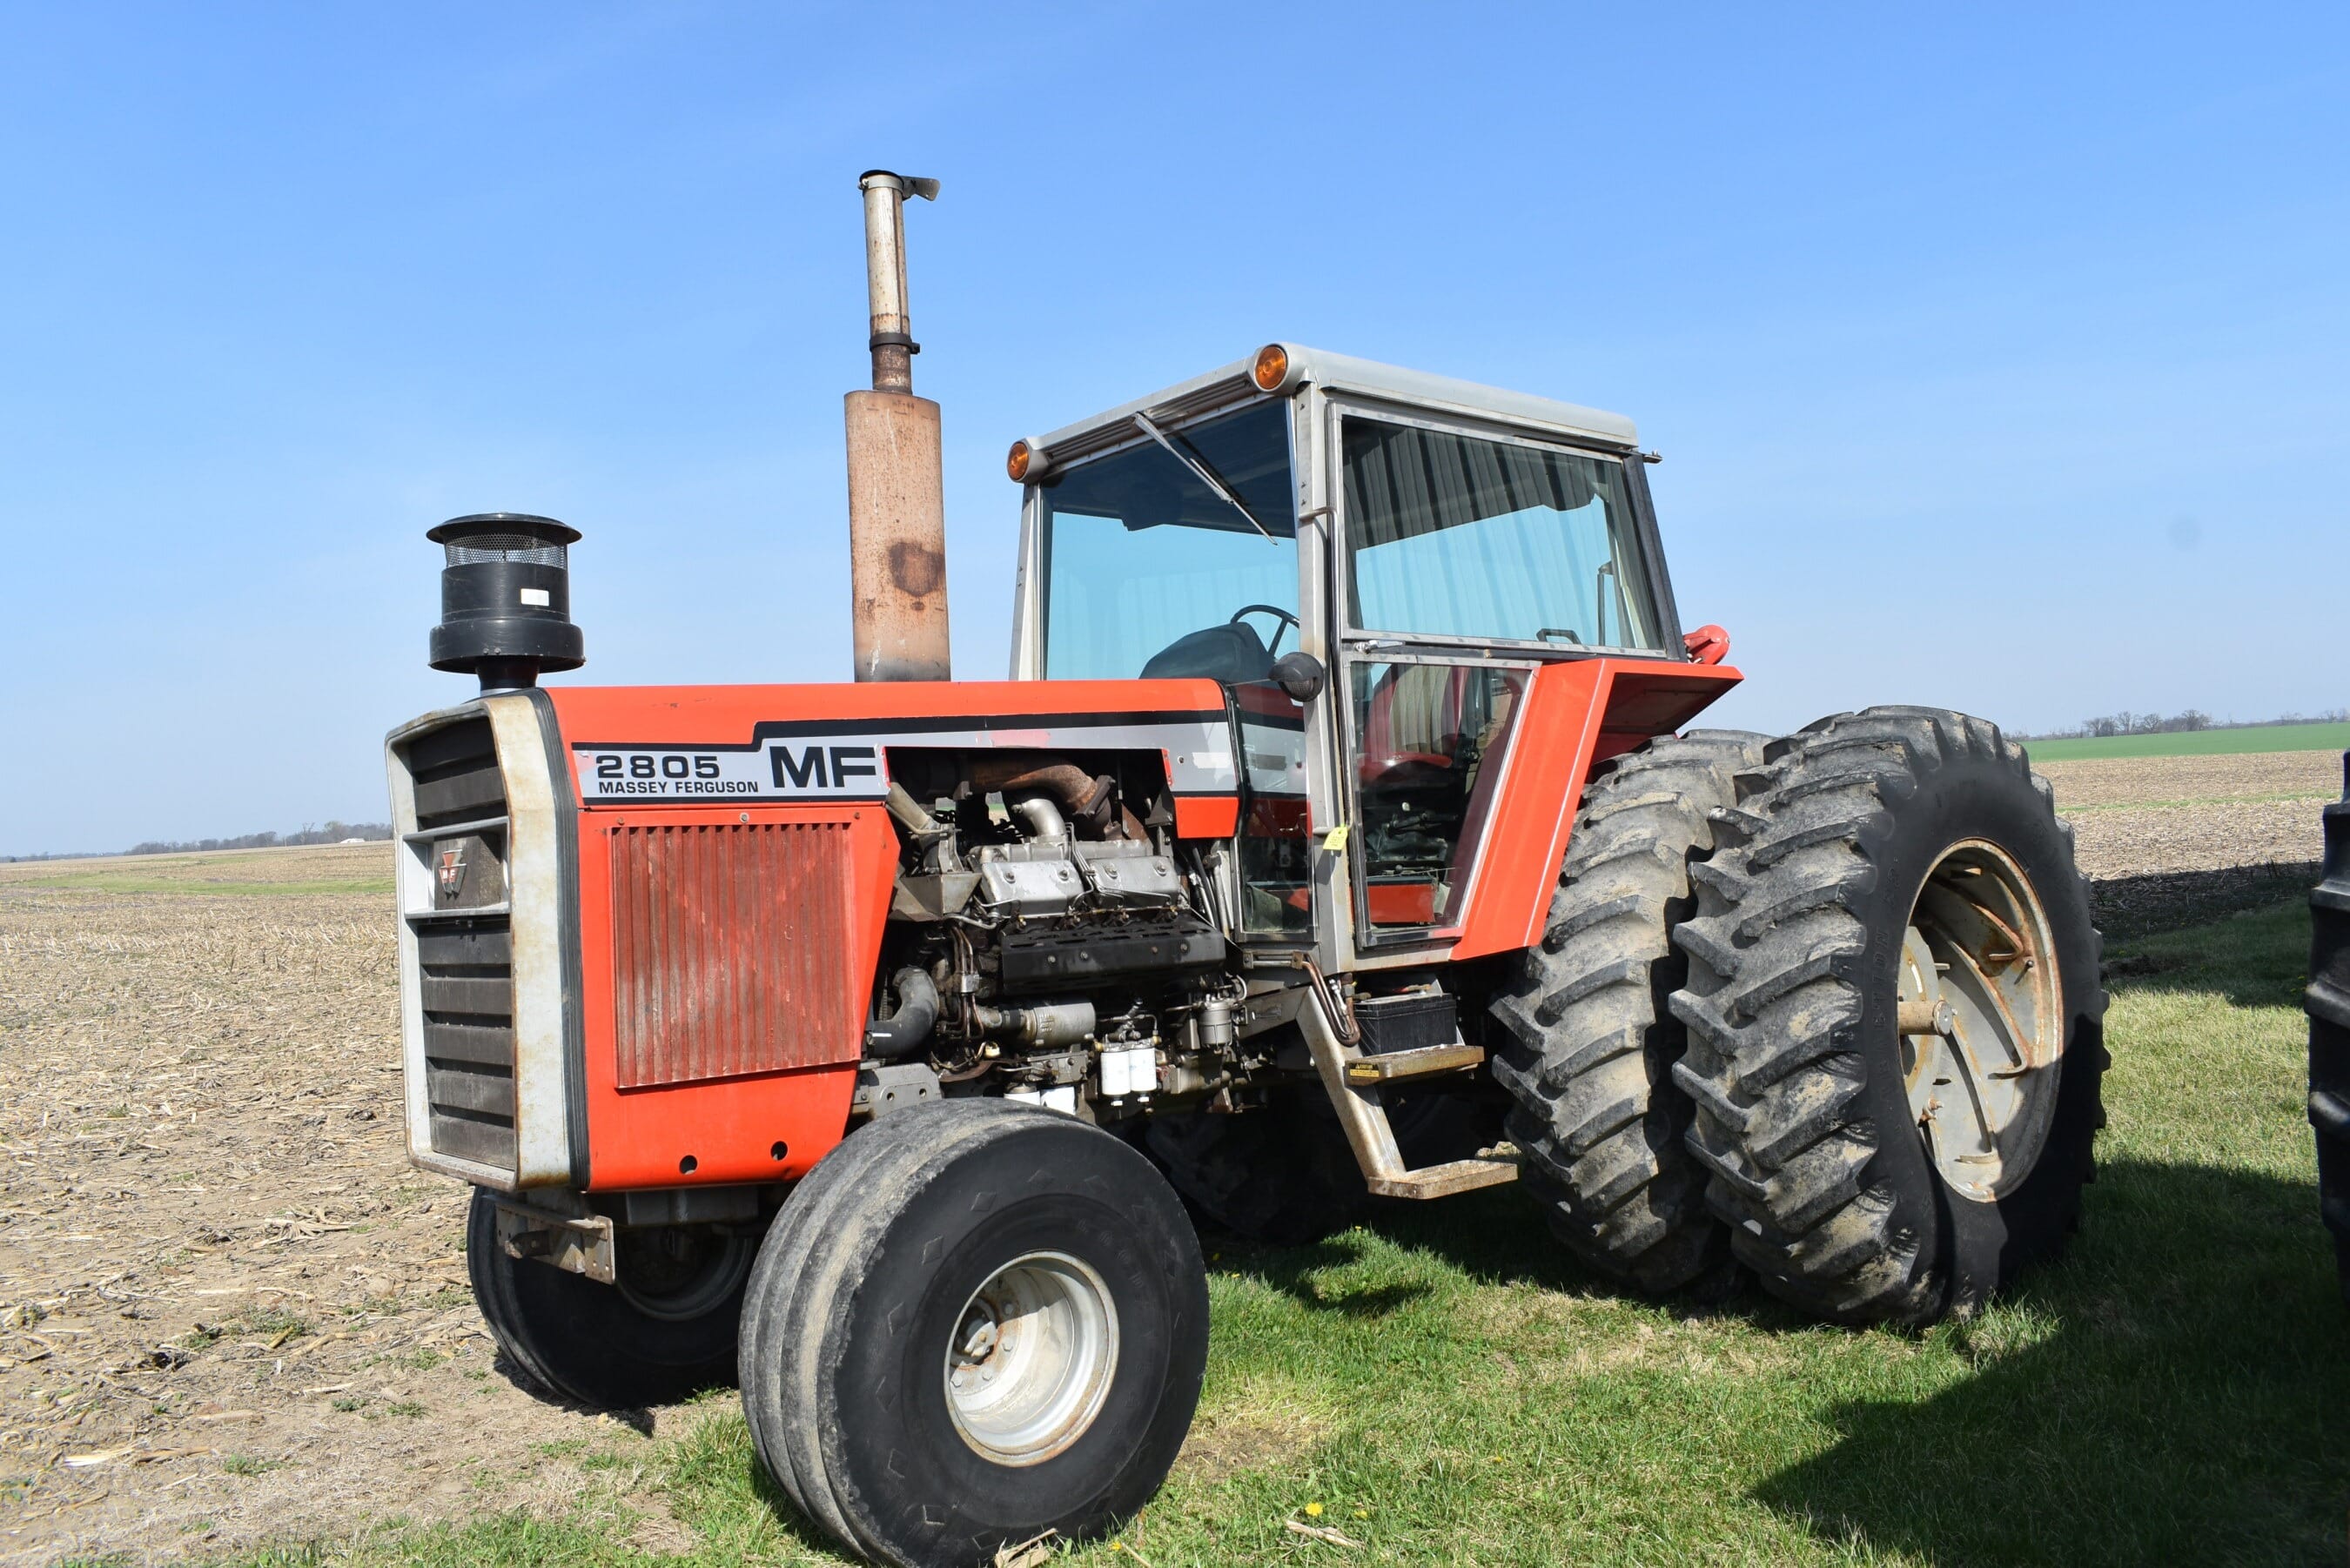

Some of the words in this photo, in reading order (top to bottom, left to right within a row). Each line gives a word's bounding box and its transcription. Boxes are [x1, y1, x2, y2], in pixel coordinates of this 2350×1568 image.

[595, 754, 721, 779] 2805
[768, 746, 876, 788] MF
[598, 781, 668, 794] MASSEY
[675, 781, 759, 794] FERGUSON
